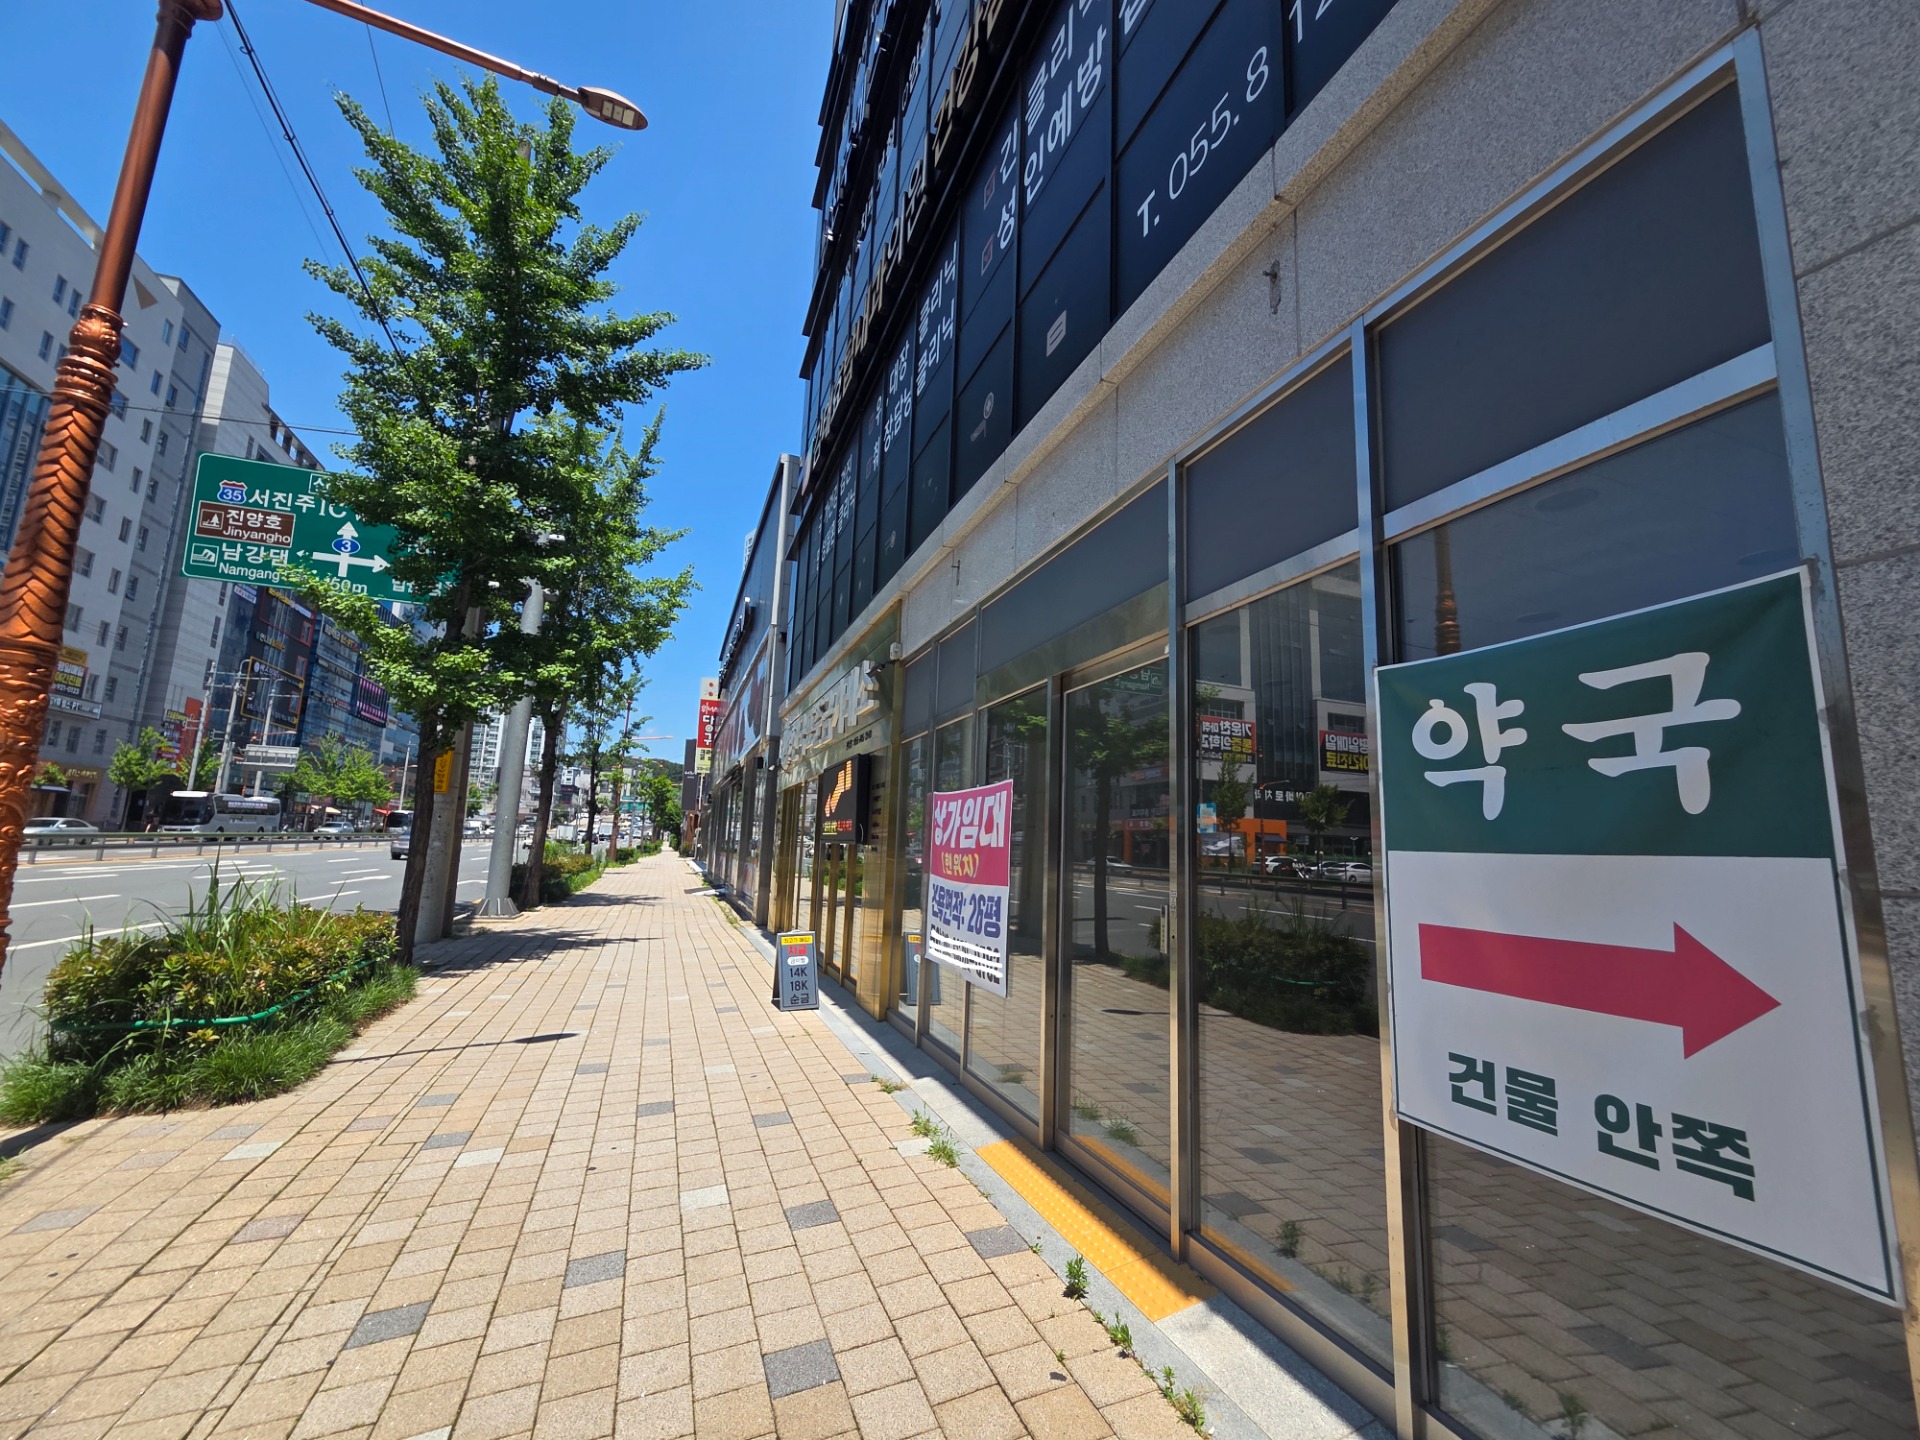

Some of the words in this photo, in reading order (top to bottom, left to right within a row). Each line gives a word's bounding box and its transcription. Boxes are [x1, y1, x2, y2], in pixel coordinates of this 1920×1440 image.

[919, 240, 957, 346] 클리닉
[916, 298, 955, 398] 클리닉
[222, 488, 242, 501] 35
[226, 508, 282, 531] 진양호
[222, 525, 292, 545] Jinyangho
[340, 540, 351, 553] 3
[222, 542, 289, 567] 남강댐
[218, 562, 281, 584] Namgang
[1412, 651, 1742, 821] 약국
[934, 790, 1007, 849] 상가임대
[941, 852, 980, 878] (현위치)
[967, 893, 1001, 939] 26평
[790, 967, 808, 978] 14K
[790, 980, 808, 991] 18K
[790, 993, 809, 1005] 순금
[1447, 1051, 1559, 1138] 건물
[1592, 1092, 1756, 1203] 안쪽
